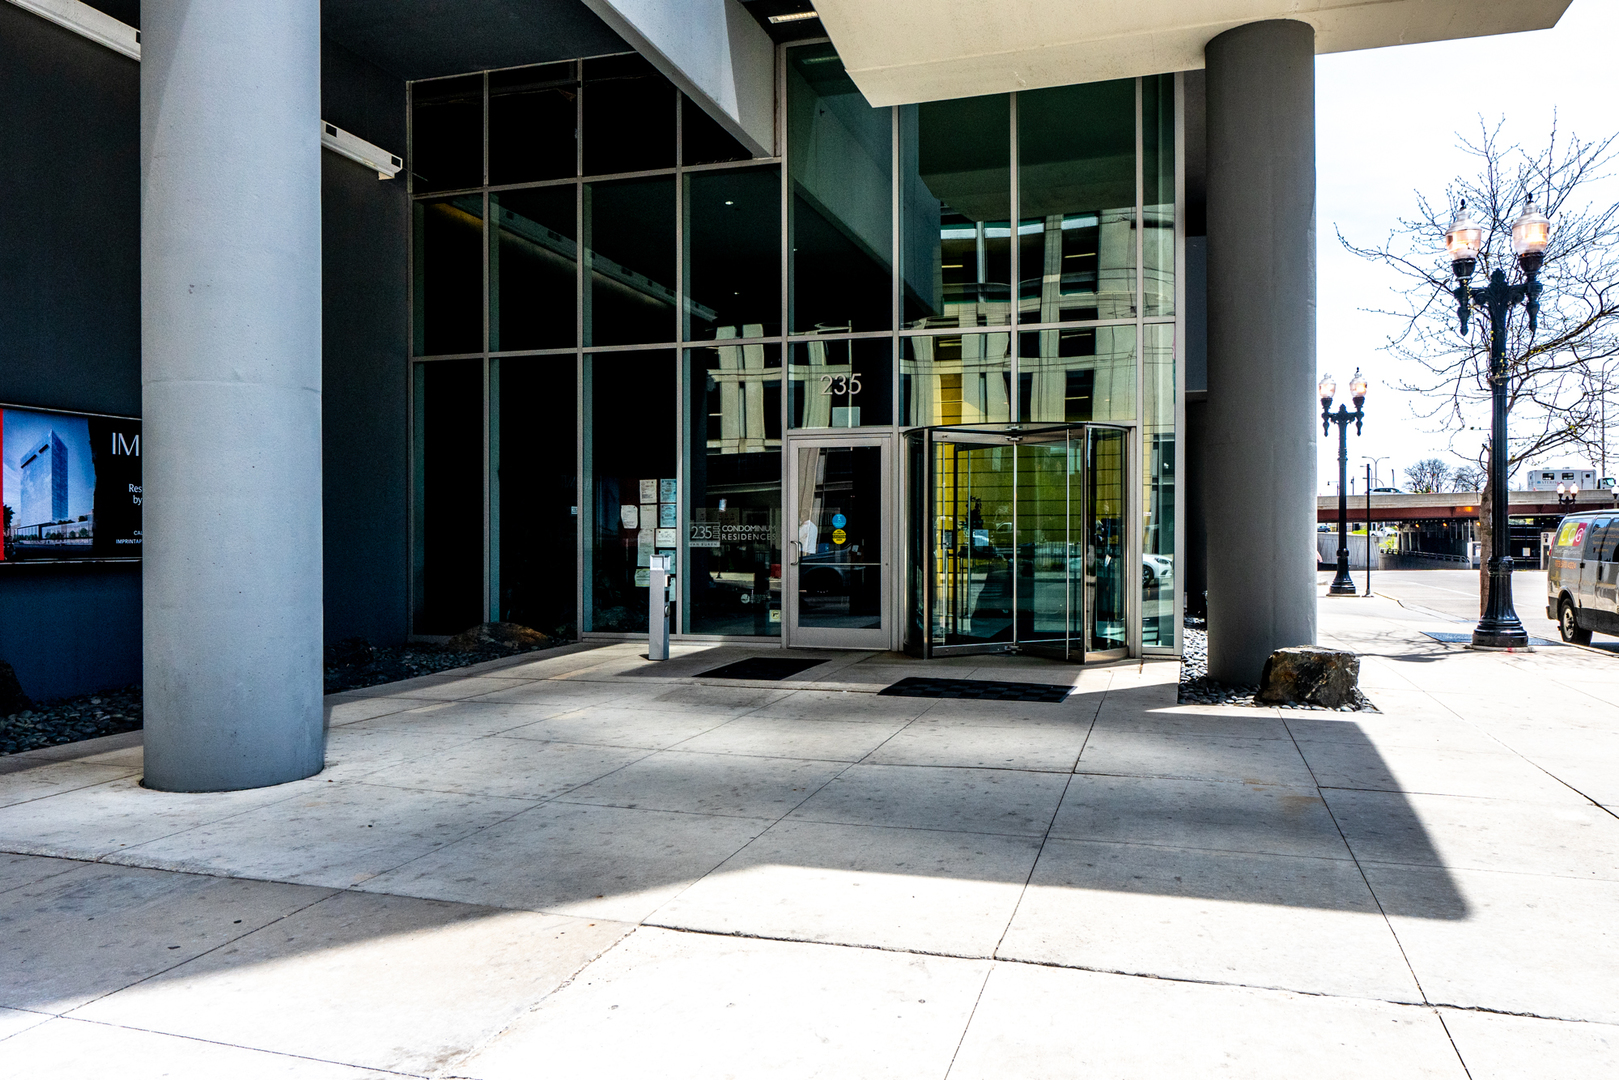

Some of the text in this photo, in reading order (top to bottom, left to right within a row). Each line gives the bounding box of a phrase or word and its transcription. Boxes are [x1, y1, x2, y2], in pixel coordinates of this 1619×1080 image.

[820, 373, 862, 395] 235
[112, 432, 139, 456] IM
[129, 484, 142, 493] Res
[691, 526, 712, 539] 235
[721, 533, 776, 541] RESIDENCES
